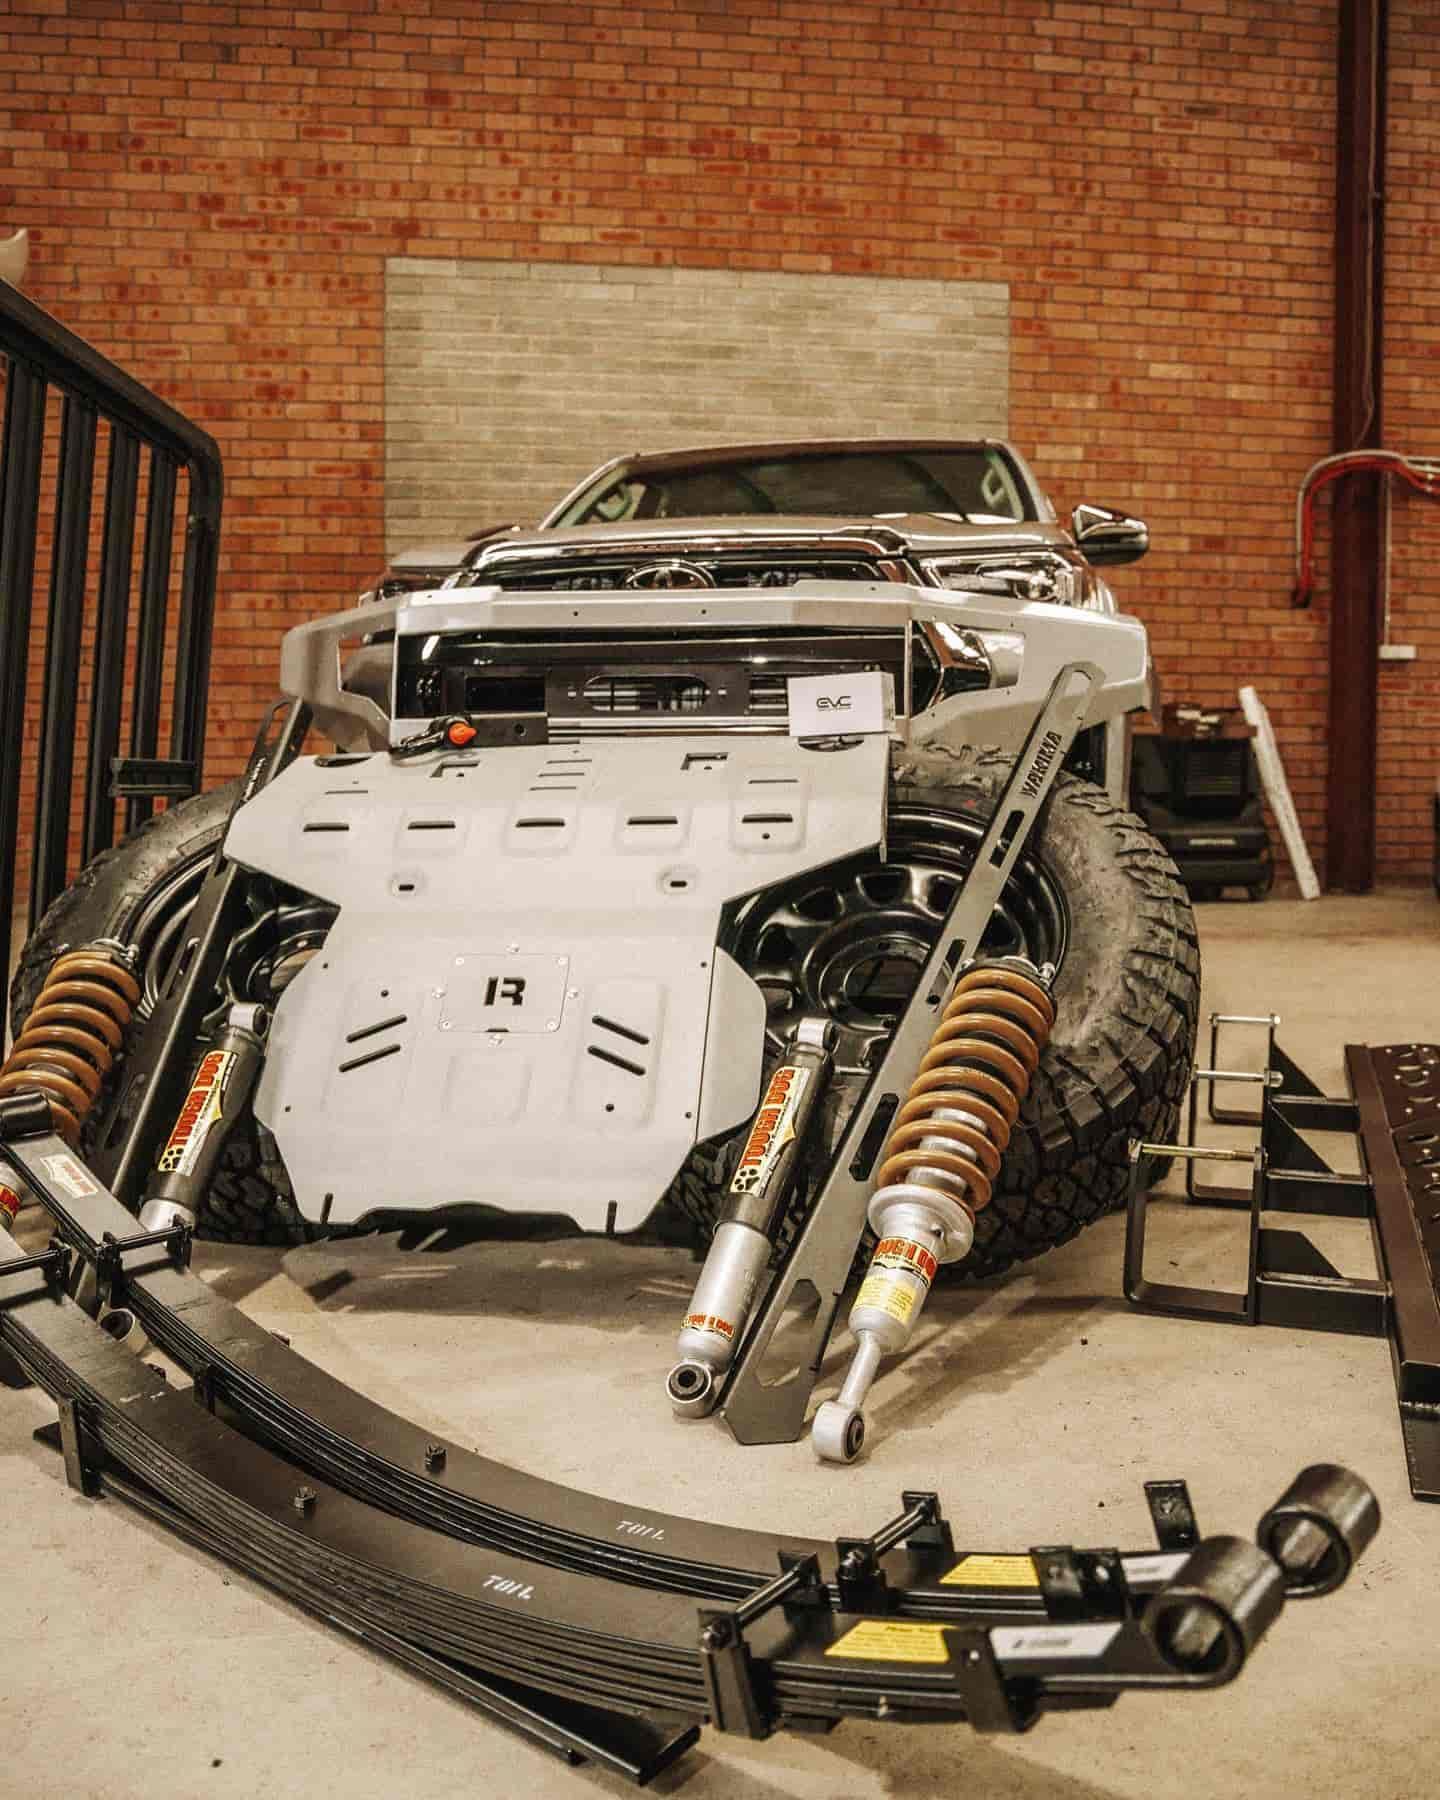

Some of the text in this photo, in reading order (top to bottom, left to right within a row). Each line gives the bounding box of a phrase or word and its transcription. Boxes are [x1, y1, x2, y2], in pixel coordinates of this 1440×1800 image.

[816, 695, 852, 708] EVC
[167, 1089, 209, 1149] TOUGH
[740, 1108, 780, 1168] TOUGH
[763, 1069, 795, 1106] DOG
